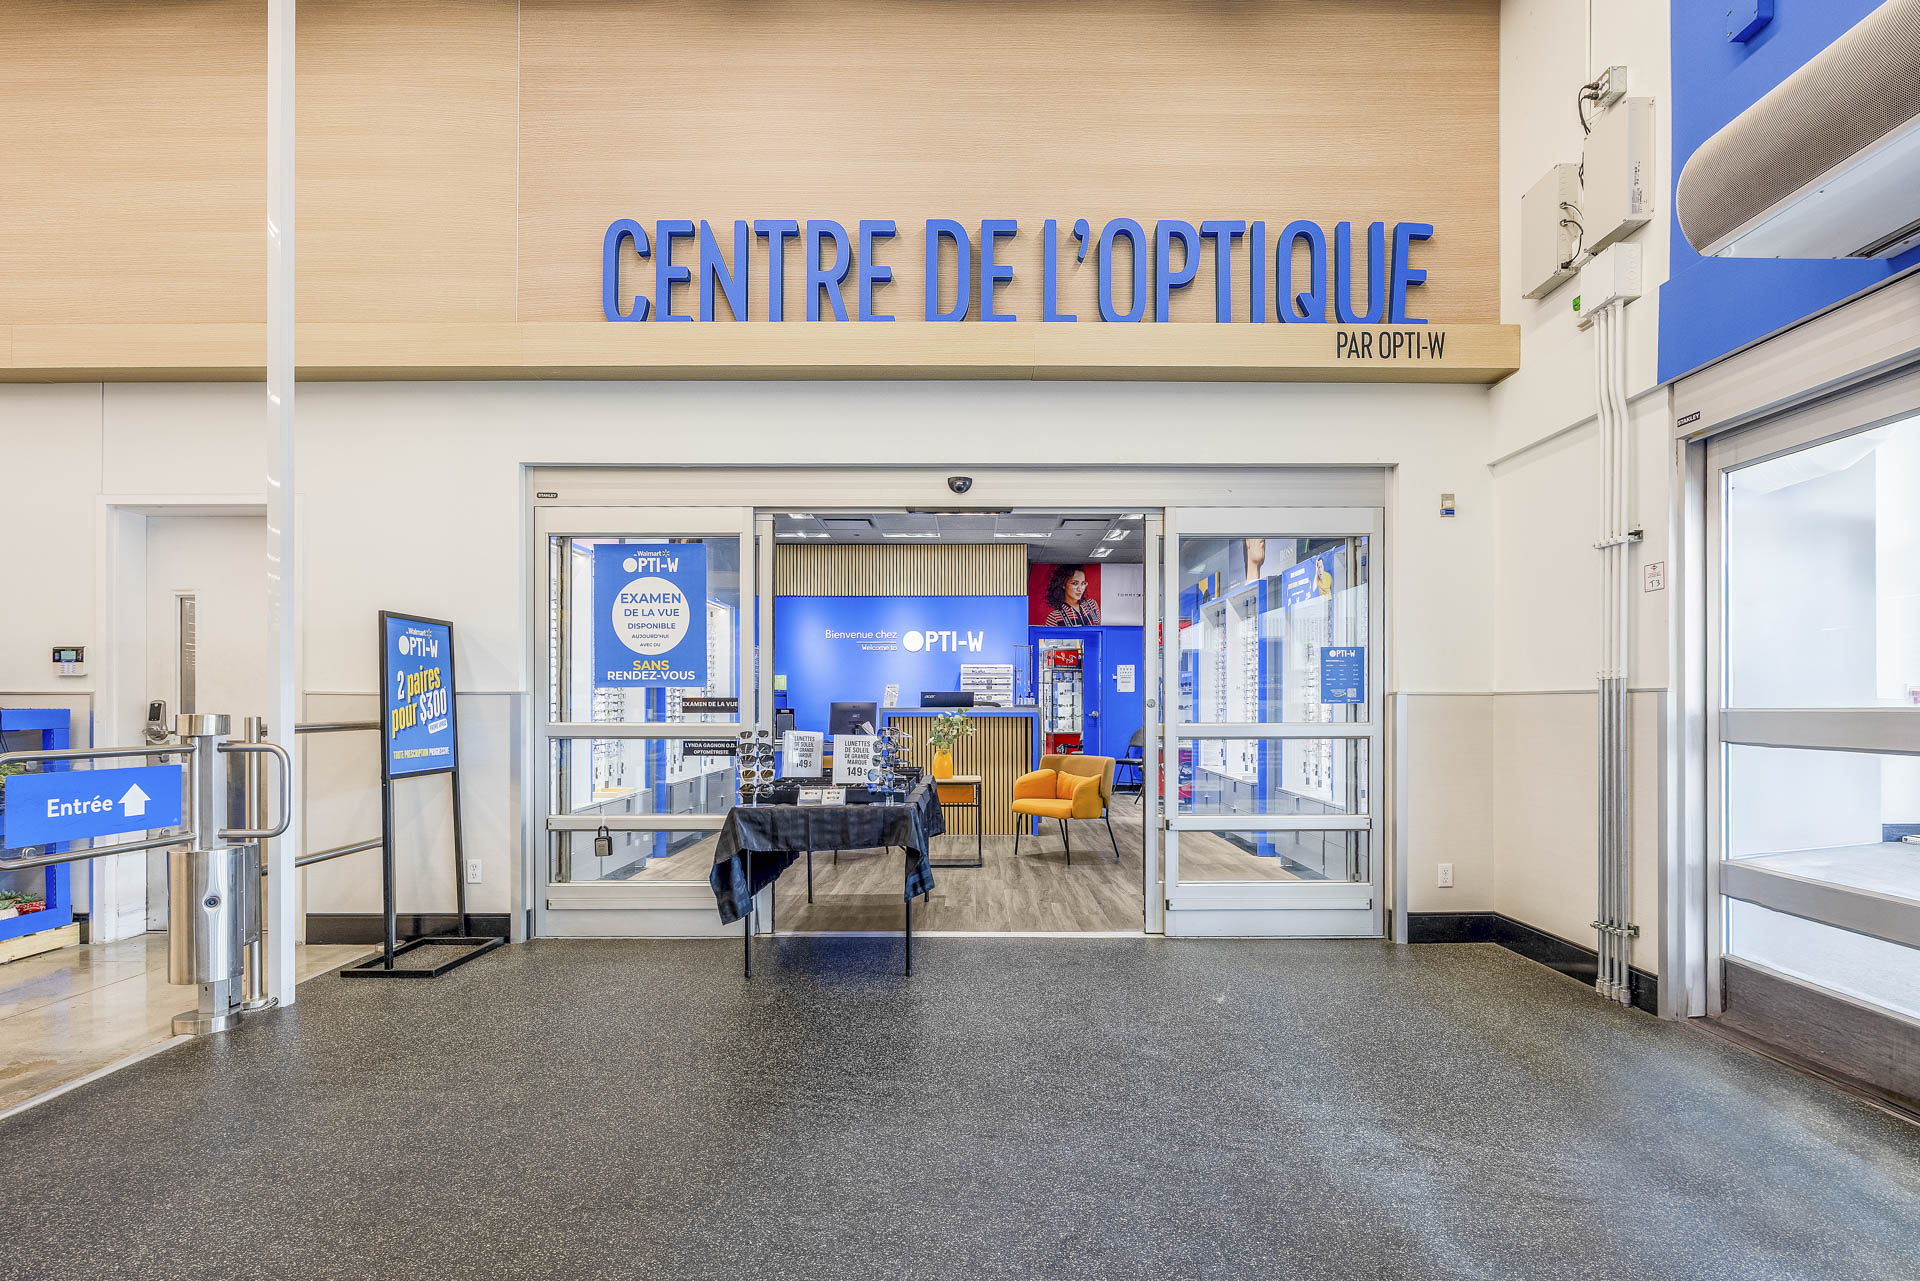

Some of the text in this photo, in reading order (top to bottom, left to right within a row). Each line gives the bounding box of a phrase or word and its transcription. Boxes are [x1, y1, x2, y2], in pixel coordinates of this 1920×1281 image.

[602, 218, 1433, 324] CENTRE DE L'OPTIQUE
[1336, 332, 1445, 359] PAR OPTI-W
[623, 557, 679, 573] OPTI-W
[620, 593, 681, 603] EXAMEN
[624, 608, 680, 616] DE LA VUE
[825, 629, 897, 639] Bienvenue chez
[903, 630, 984, 652] OPTI-W
[398, 635, 438, 658] OPTI-W
[607, 671, 696, 680] RENDEZ-VOUS
[633, 660, 670, 670] SANS
[397, 665, 441, 703] 2 paires
[392, 702, 418, 739] pour
[47, 795, 113, 817] Entrée
